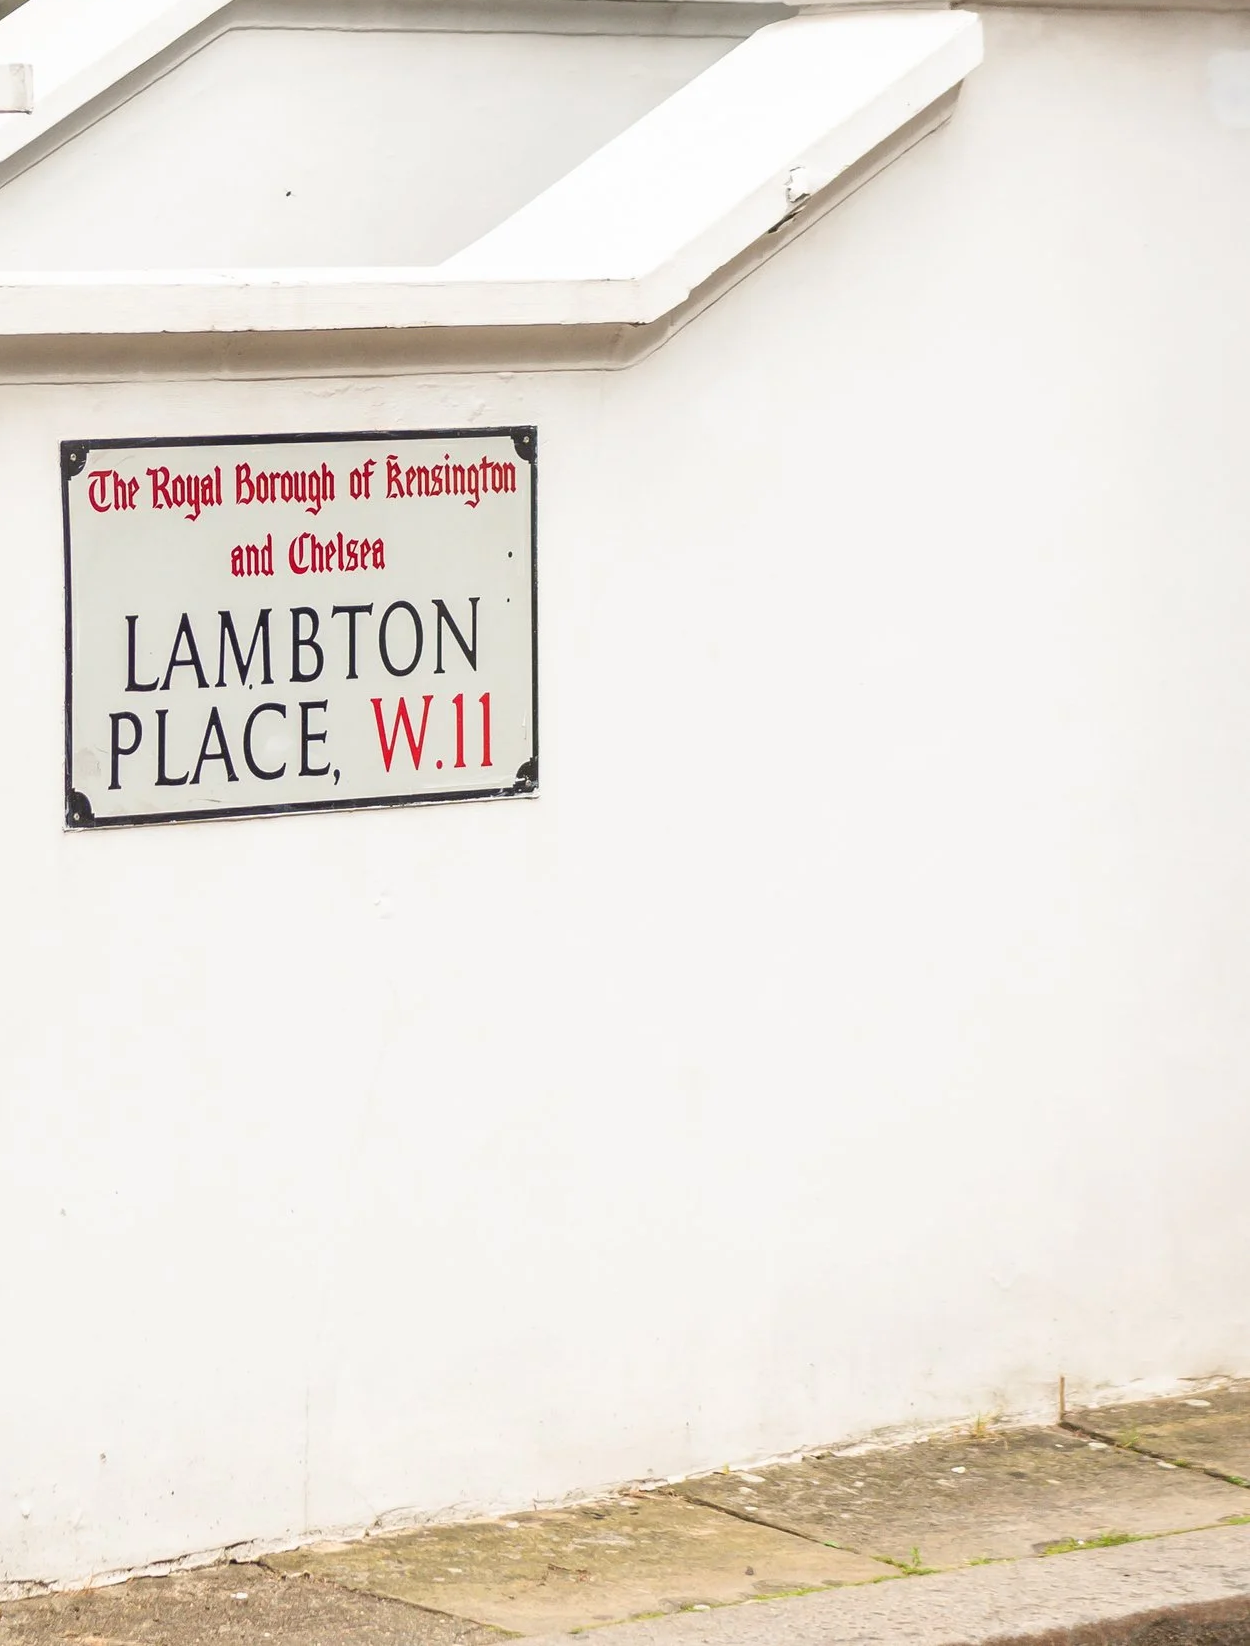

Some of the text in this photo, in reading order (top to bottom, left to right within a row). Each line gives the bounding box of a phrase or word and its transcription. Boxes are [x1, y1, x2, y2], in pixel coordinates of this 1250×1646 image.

[87, 453, 517, 522] The Royal Borough of Kensington
[230, 531, 386, 578] and Chelsea
[124, 596, 481, 692] LAMBTON
[107, 691, 493, 791] PLACE, W.11
